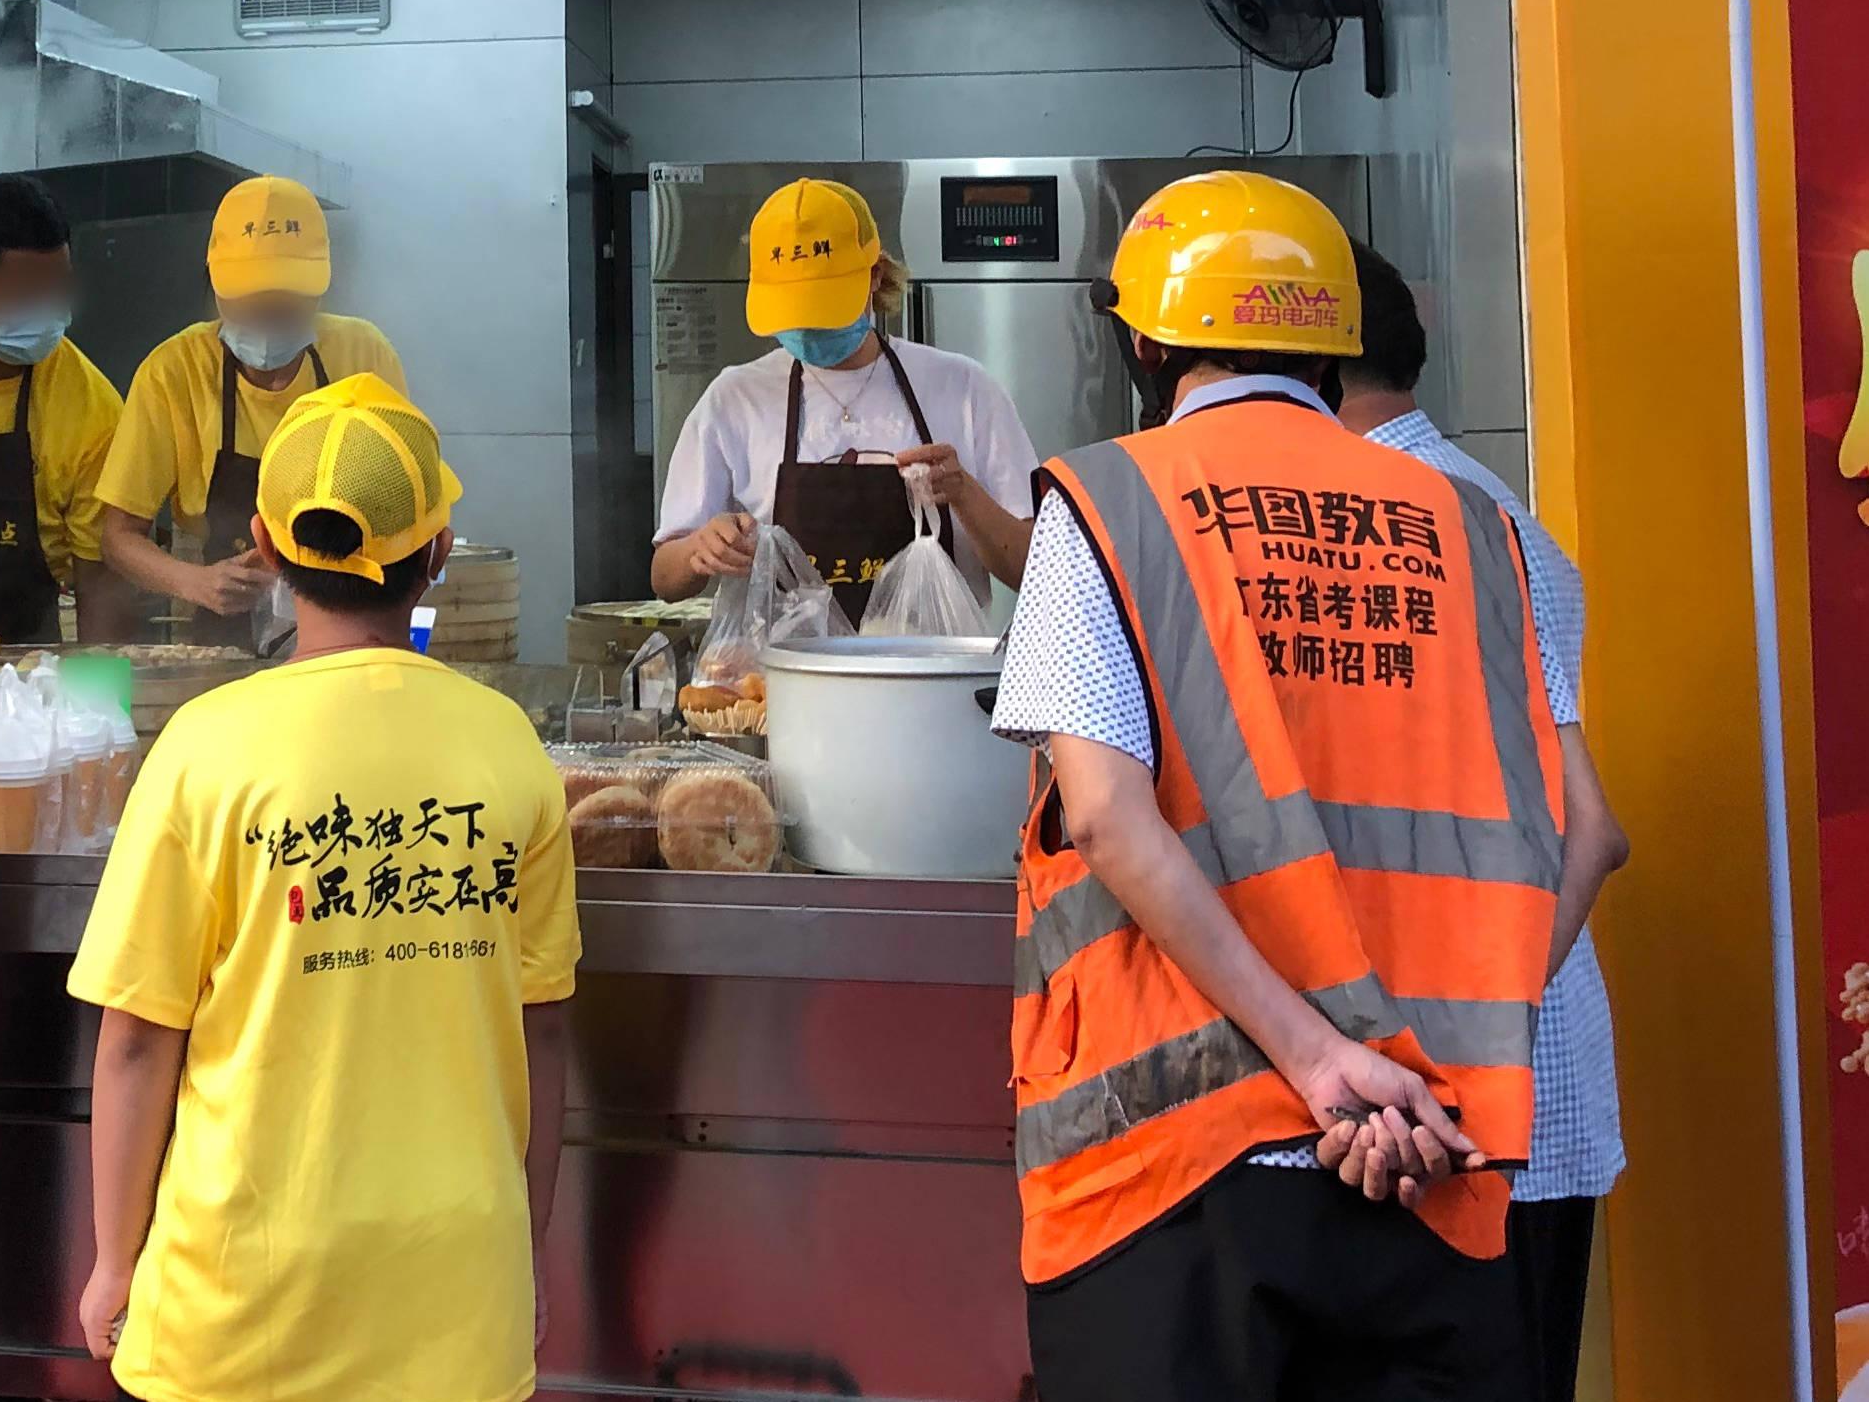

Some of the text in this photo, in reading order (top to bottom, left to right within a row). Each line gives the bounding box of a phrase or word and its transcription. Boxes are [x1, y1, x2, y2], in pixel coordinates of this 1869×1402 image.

[1233, 306, 1339, 328] 爱玛电动车
[1181, 482, 1442, 559] 华图教育
[312, 841, 519, 922] 品质实在高
